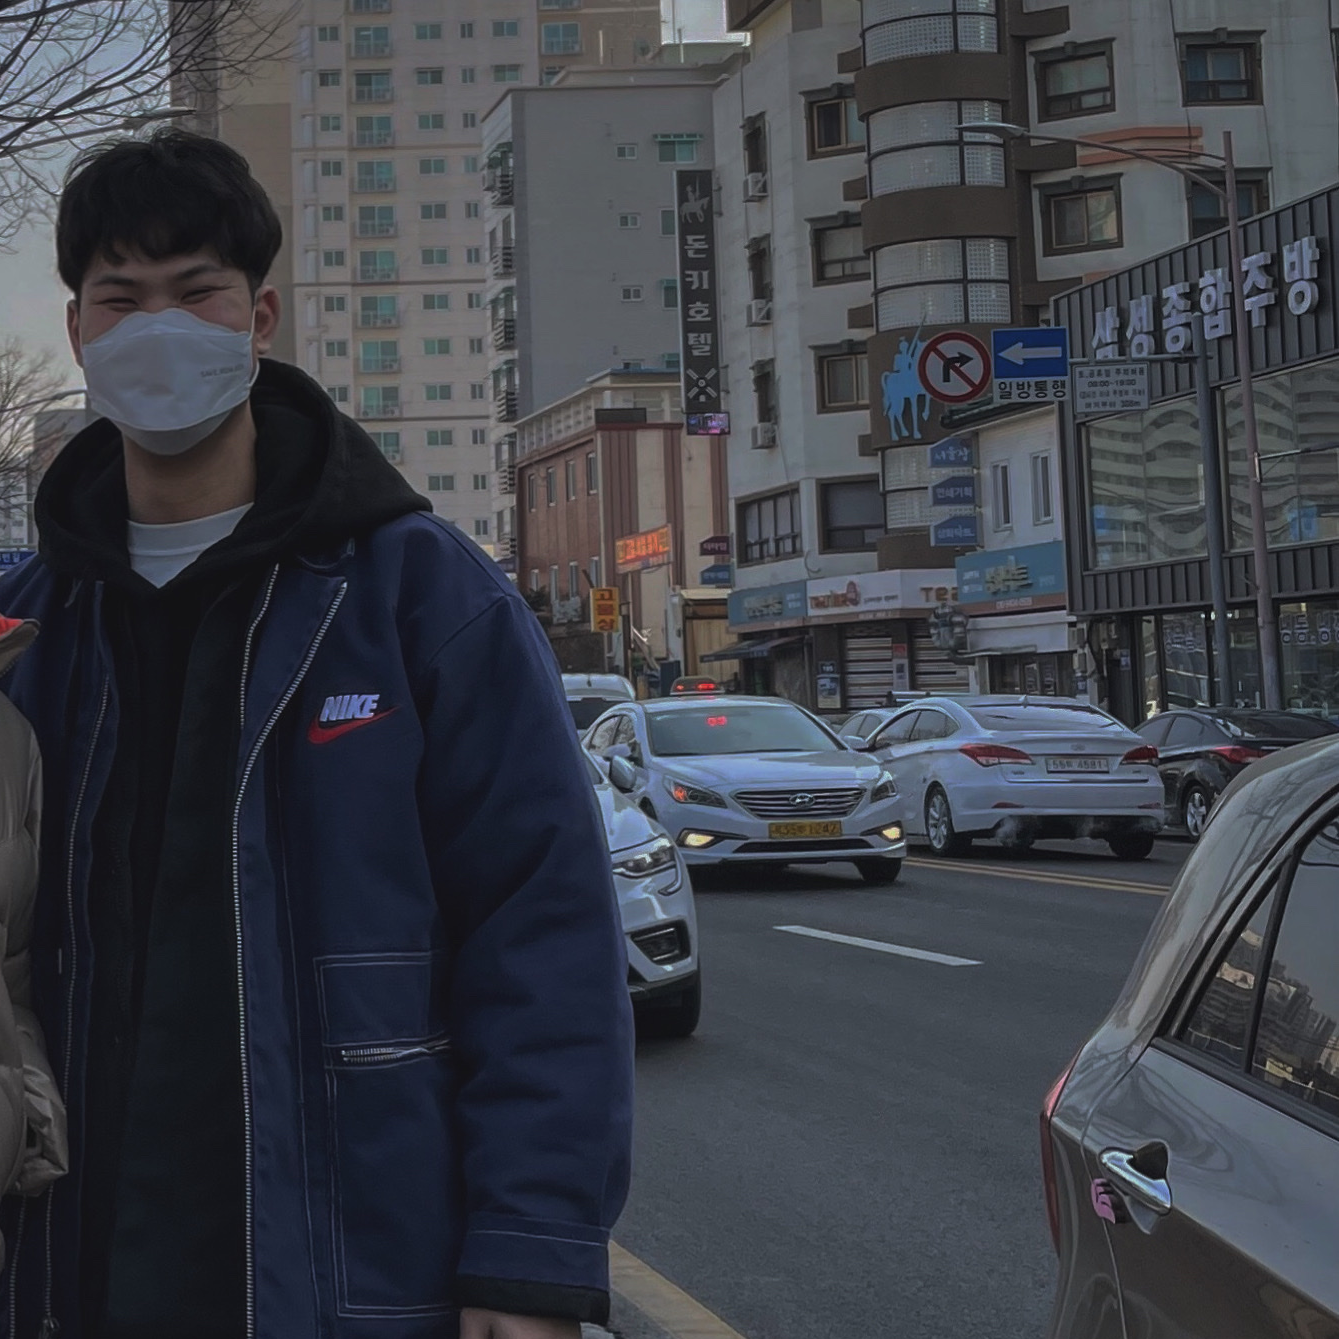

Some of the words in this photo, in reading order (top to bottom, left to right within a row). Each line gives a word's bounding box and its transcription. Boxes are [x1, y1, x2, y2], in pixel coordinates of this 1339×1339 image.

[684, 234, 712, 356] 돈키호텔
[998, 380, 1066, 400] 일방통행
[319, 694, 380, 722] NIKE
